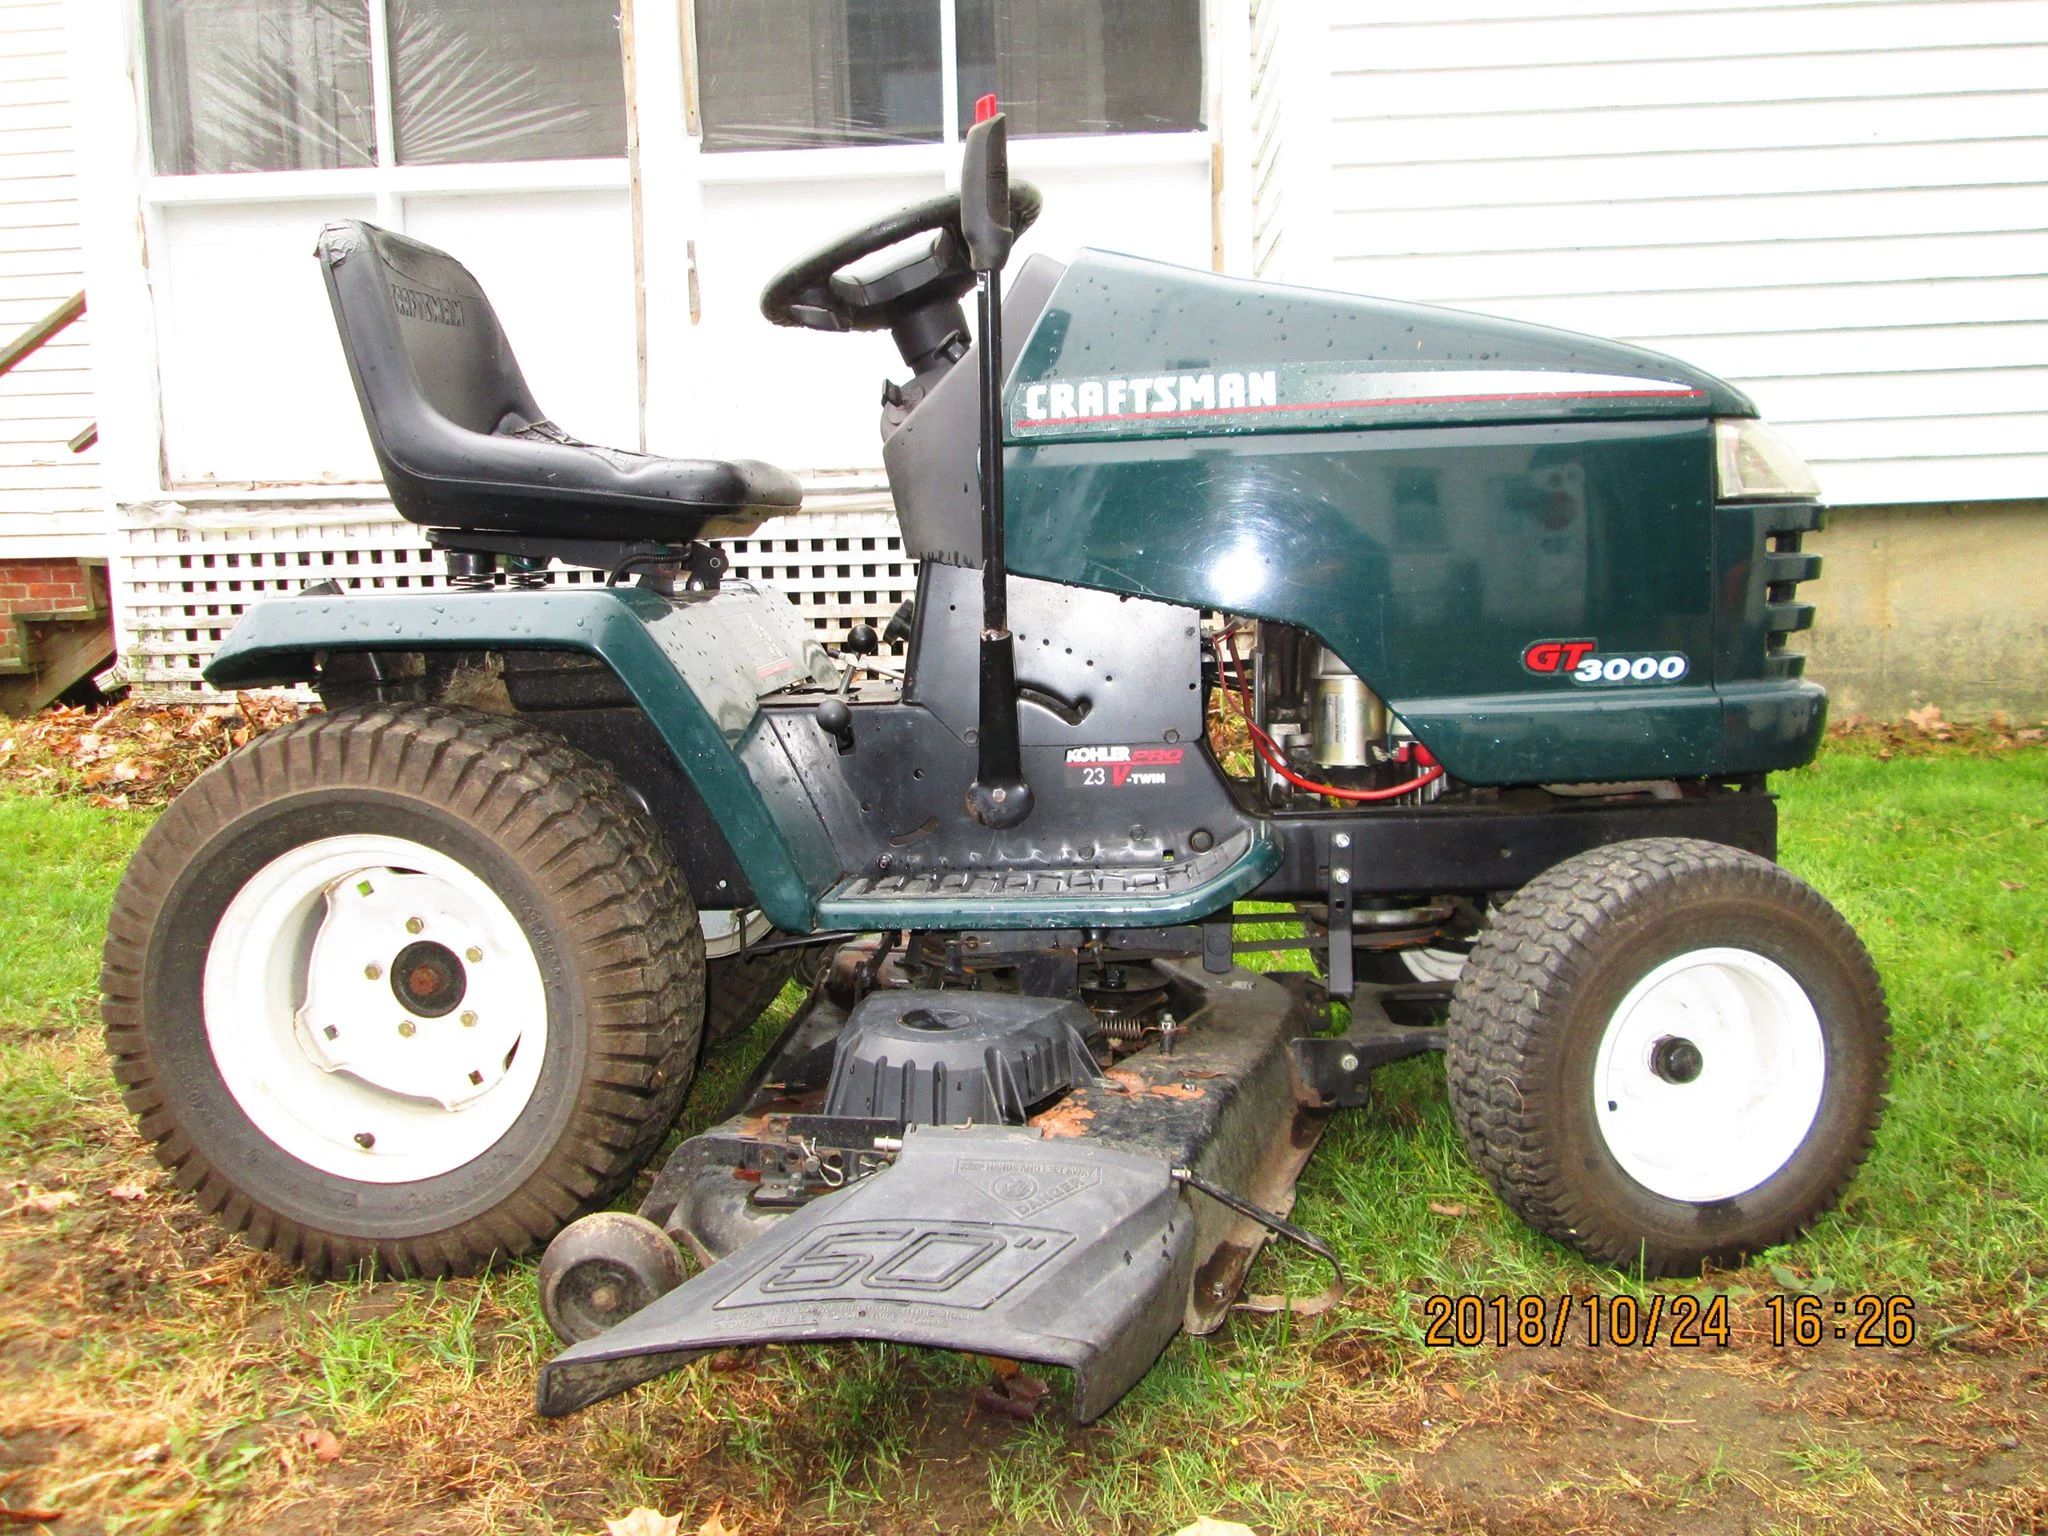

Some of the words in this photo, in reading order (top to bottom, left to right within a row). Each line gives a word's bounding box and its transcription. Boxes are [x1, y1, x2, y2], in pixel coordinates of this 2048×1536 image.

[1025, 371, 1277, 421] CRAFTSMAN
[1525, 642, 1595, 673] GT
[1574, 656, 1686, 682] 3000
[1066, 746, 1131, 763] KOHLER
[1083, 767, 1106, 786] 23
[1111, 765, 1166, 787] V-TWIN
[1014, 1177, 1086, 1216] DAGER
